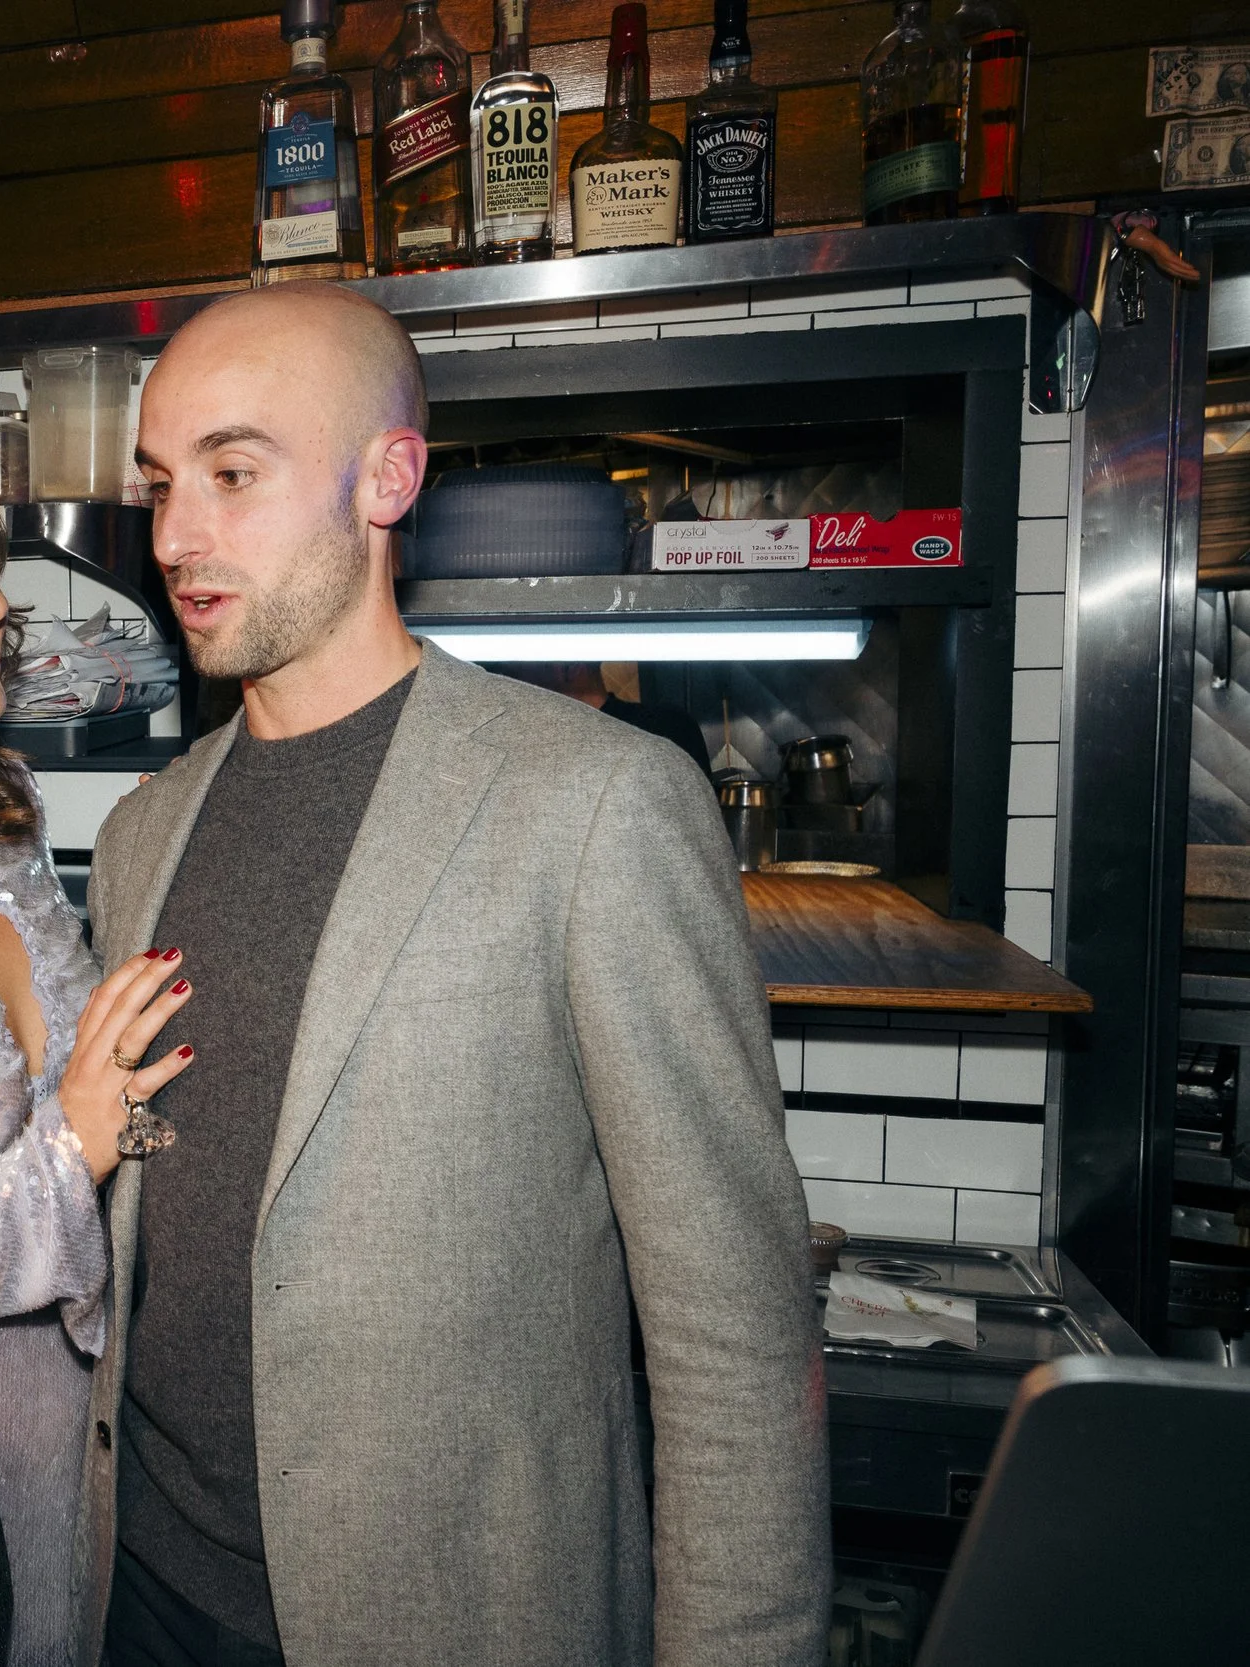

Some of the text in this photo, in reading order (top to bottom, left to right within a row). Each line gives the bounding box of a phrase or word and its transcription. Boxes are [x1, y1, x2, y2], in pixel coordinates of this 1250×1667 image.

[487, 106, 548, 147] 818
[388, 114, 453, 155] Red Label
[697, 126, 769, 156] JACK DANIEL'S
[275, 141, 325, 166] 1800
[487, 147, 548, 167] TEQUILA
[720, 154, 744, 164] No.7
[286, 164, 317, 174] TEQUILA
[487, 164, 549, 184] BLANCO
[585, 166, 670, 186] Maker's
[487, 183, 504, 191] 100%
[505, 180, 529, 188] AGAVE
[708, 174, 755, 186] Tennessee
[609, 184, 669, 201] Mark
[708, 187, 755, 198] WHISKEY
[600, 207, 655, 218] WHISKY
[277, 222, 320, 246] Blanco
[932, 513, 957, 522] FW-15
[666, 525, 707, 539] crystal
[815, 516, 866, 550] Deli
[666, 551, 745, 565] POP UP FOIL
[823, 556, 839, 564] sheets
